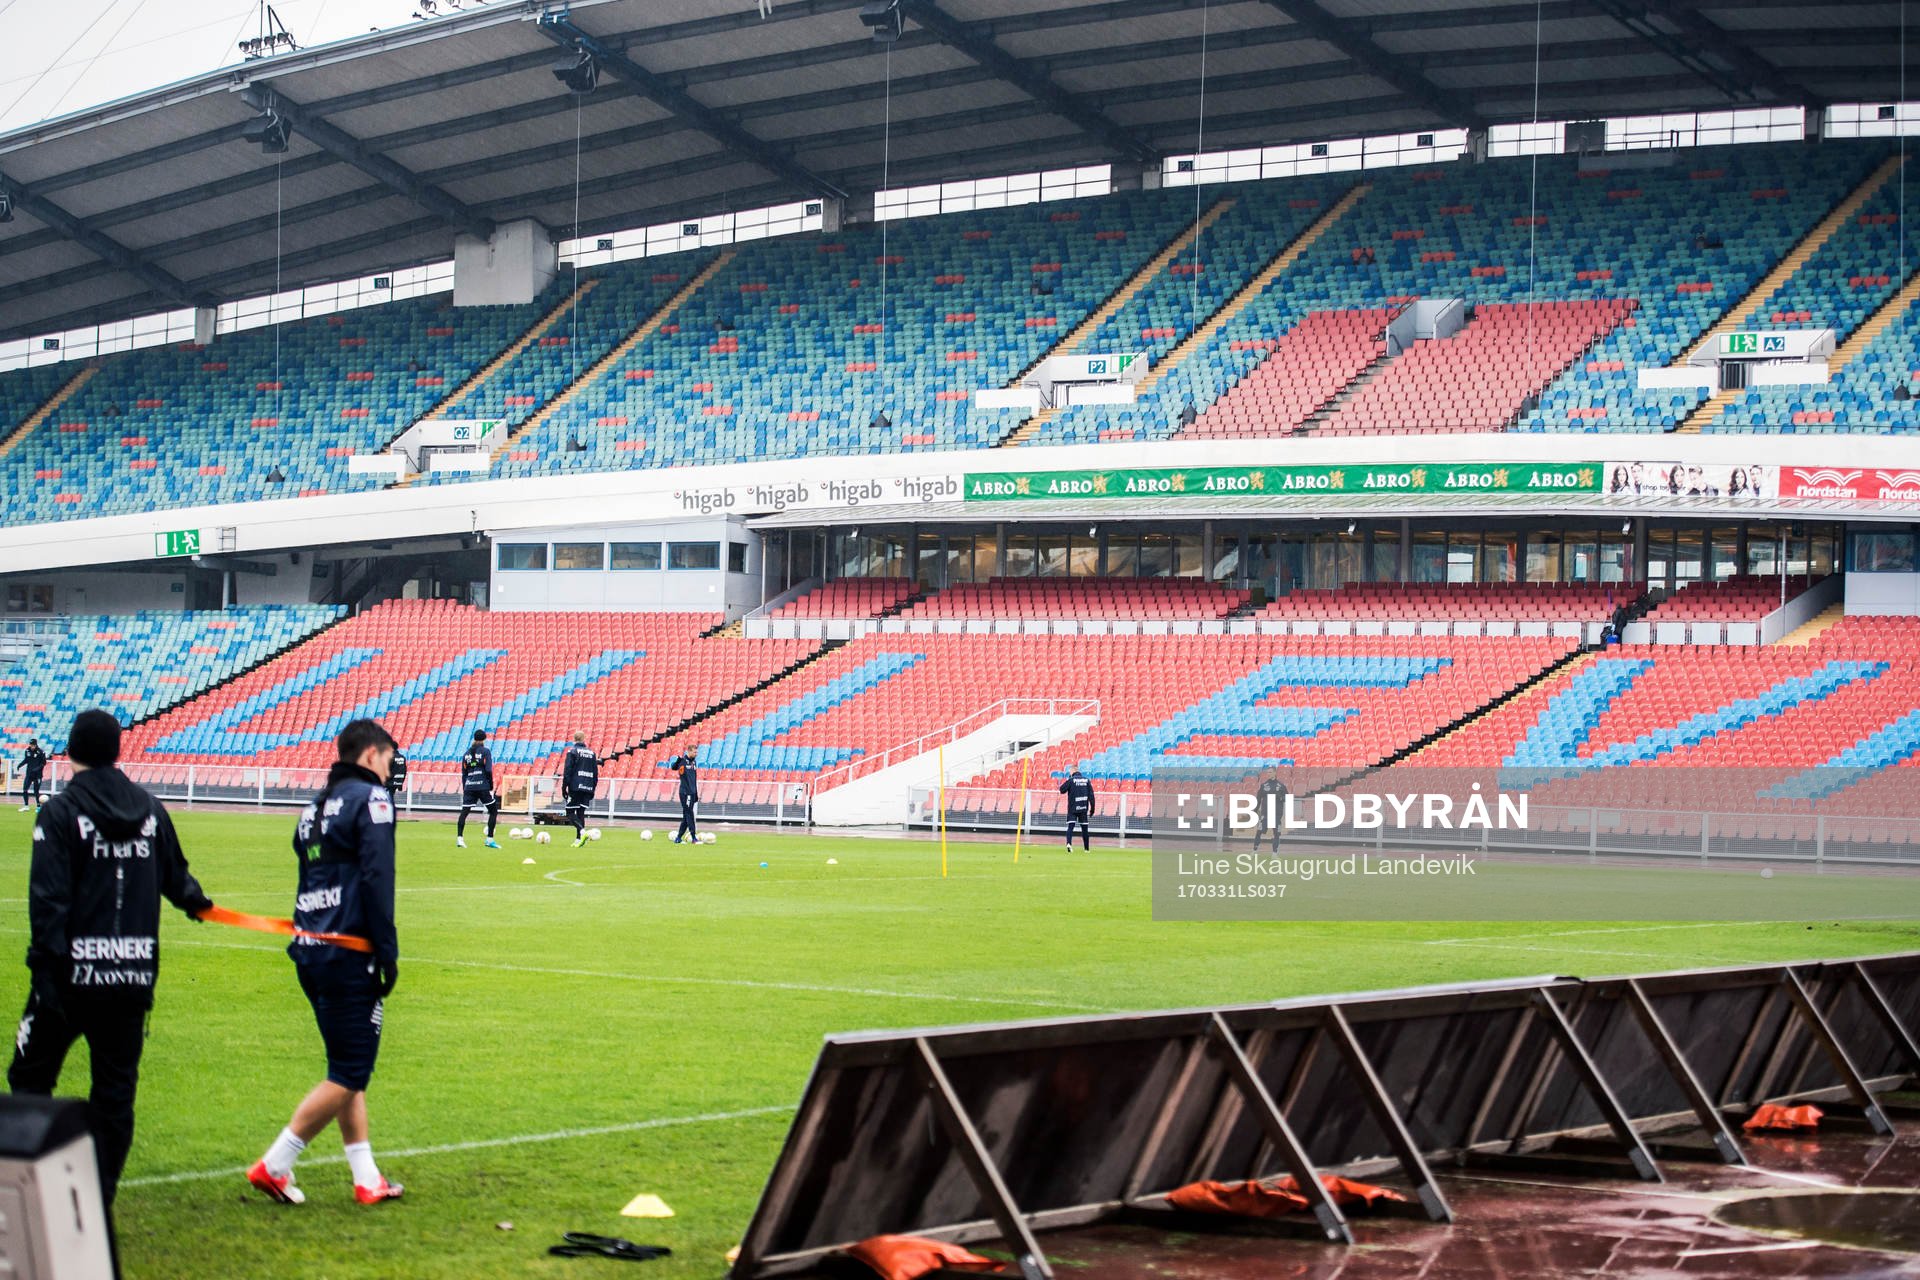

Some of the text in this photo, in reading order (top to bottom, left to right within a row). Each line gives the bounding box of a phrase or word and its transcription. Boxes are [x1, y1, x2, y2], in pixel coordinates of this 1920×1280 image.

[1764, 337, 1784, 351] A2
[1090, 361, 1104, 374] P2
[454, 427, 470, 440] Q2
[756, 484, 809, 511] higab
[829, 479, 882, 505] higab
[903, 475, 958, 501] higab
[682, 488, 735, 514] higab
[71, 936, 155, 960] SERNEKE
